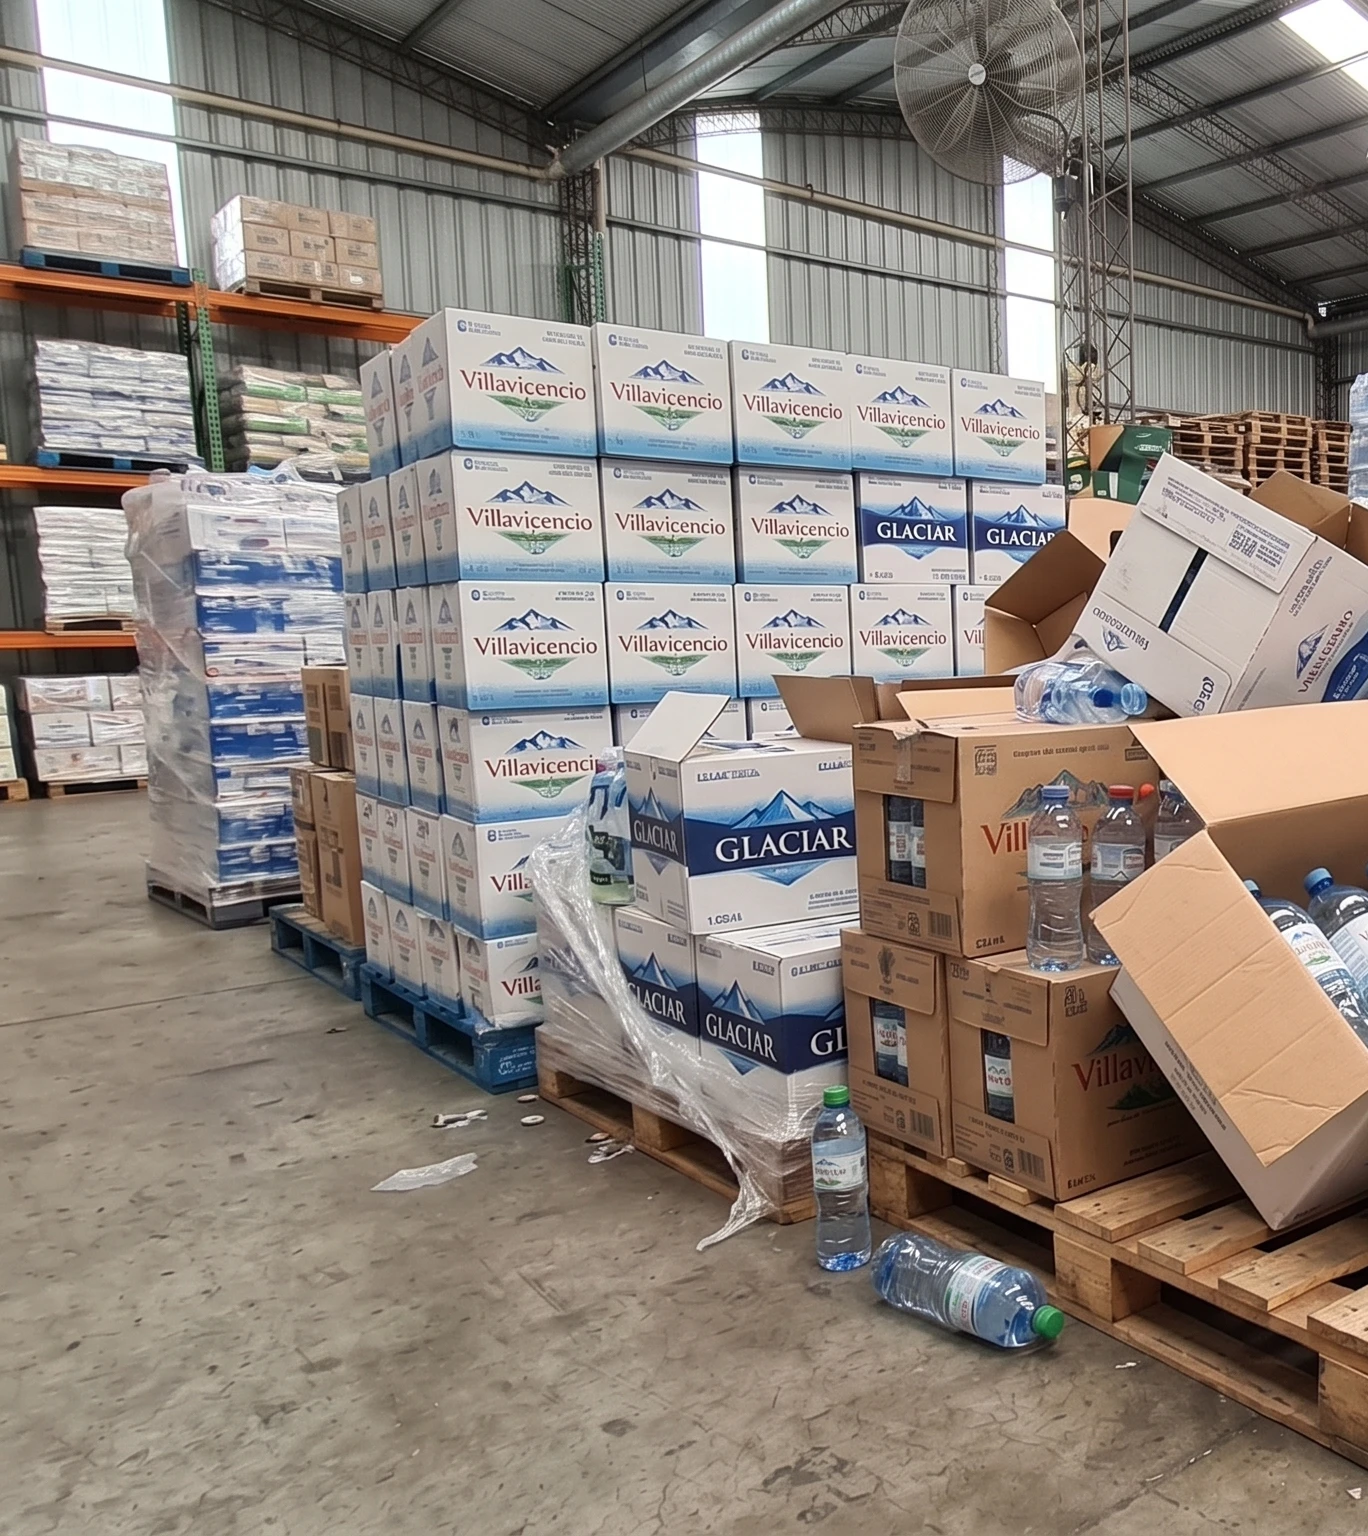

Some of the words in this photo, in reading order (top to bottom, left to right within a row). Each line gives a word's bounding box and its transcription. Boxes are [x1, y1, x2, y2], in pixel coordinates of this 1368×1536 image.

[460, 369, 587, 400] Villavicencio
[610, 382, 723, 411] Villavicencio
[743, 393, 843, 420] Villavicencio
[857, 404, 946, 430] Villavicencio
[961, 417, 1040, 441] Villavicencio
[466, 507, 593, 531] Villavicencio
[615, 512, 725, 535] Villavicencio
[751, 517, 849, 538] Villavicencio
[876, 522, 957, 541] GLACIAR
[473, 636, 598, 655] Villavicencio
[618, 635, 728, 653] Villavicencio
[745, 633, 844, 650] Villavicencio
[859, 630, 947, 647] Villavicencio
[484, 756, 600, 778] Villavicenci
[633, 820, 679, 856] GLACIAR
[715, 826, 853, 862] GLACIAR
[490, 872, 532, 893] Villa
[501, 976, 541, 997] Villa
[705, 1013, 778, 1062] GLACIAR
[811, 1027, 848, 1056] GL
